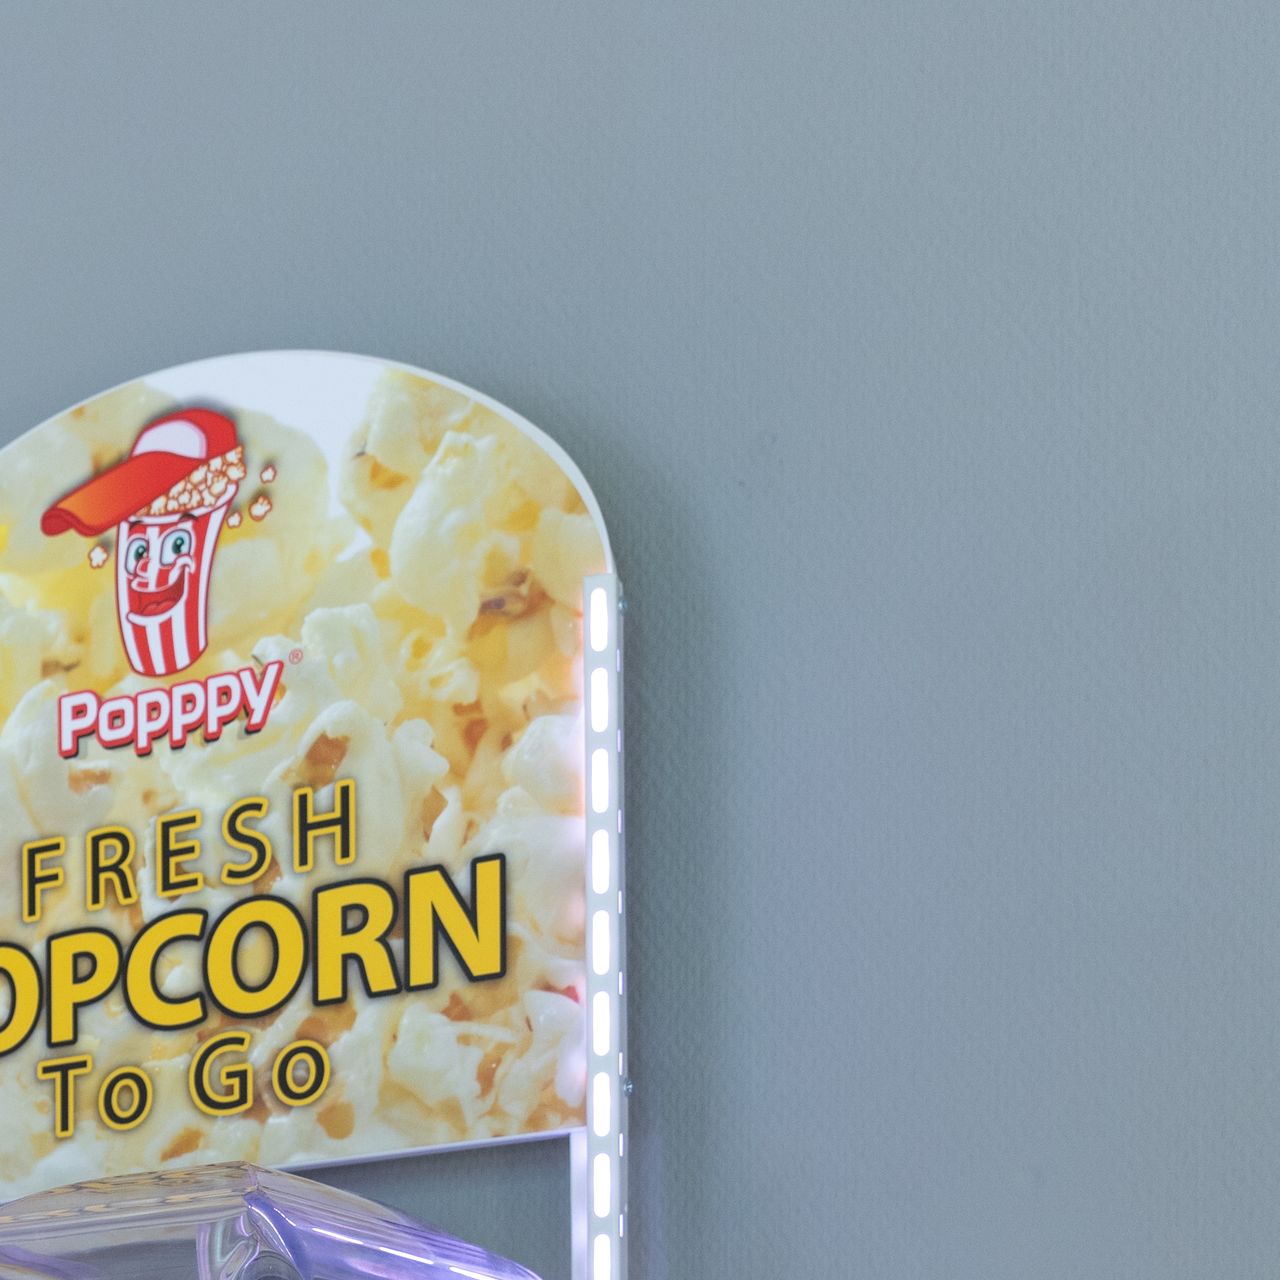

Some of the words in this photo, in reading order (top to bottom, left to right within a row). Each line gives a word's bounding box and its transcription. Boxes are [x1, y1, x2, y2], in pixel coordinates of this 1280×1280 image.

[58, 661, 284, 758] Popppy
[21, 779, 356, 923] FRESH
[38, 1054, 153, 1139] To
[189, 1031, 331, 1117] Go
